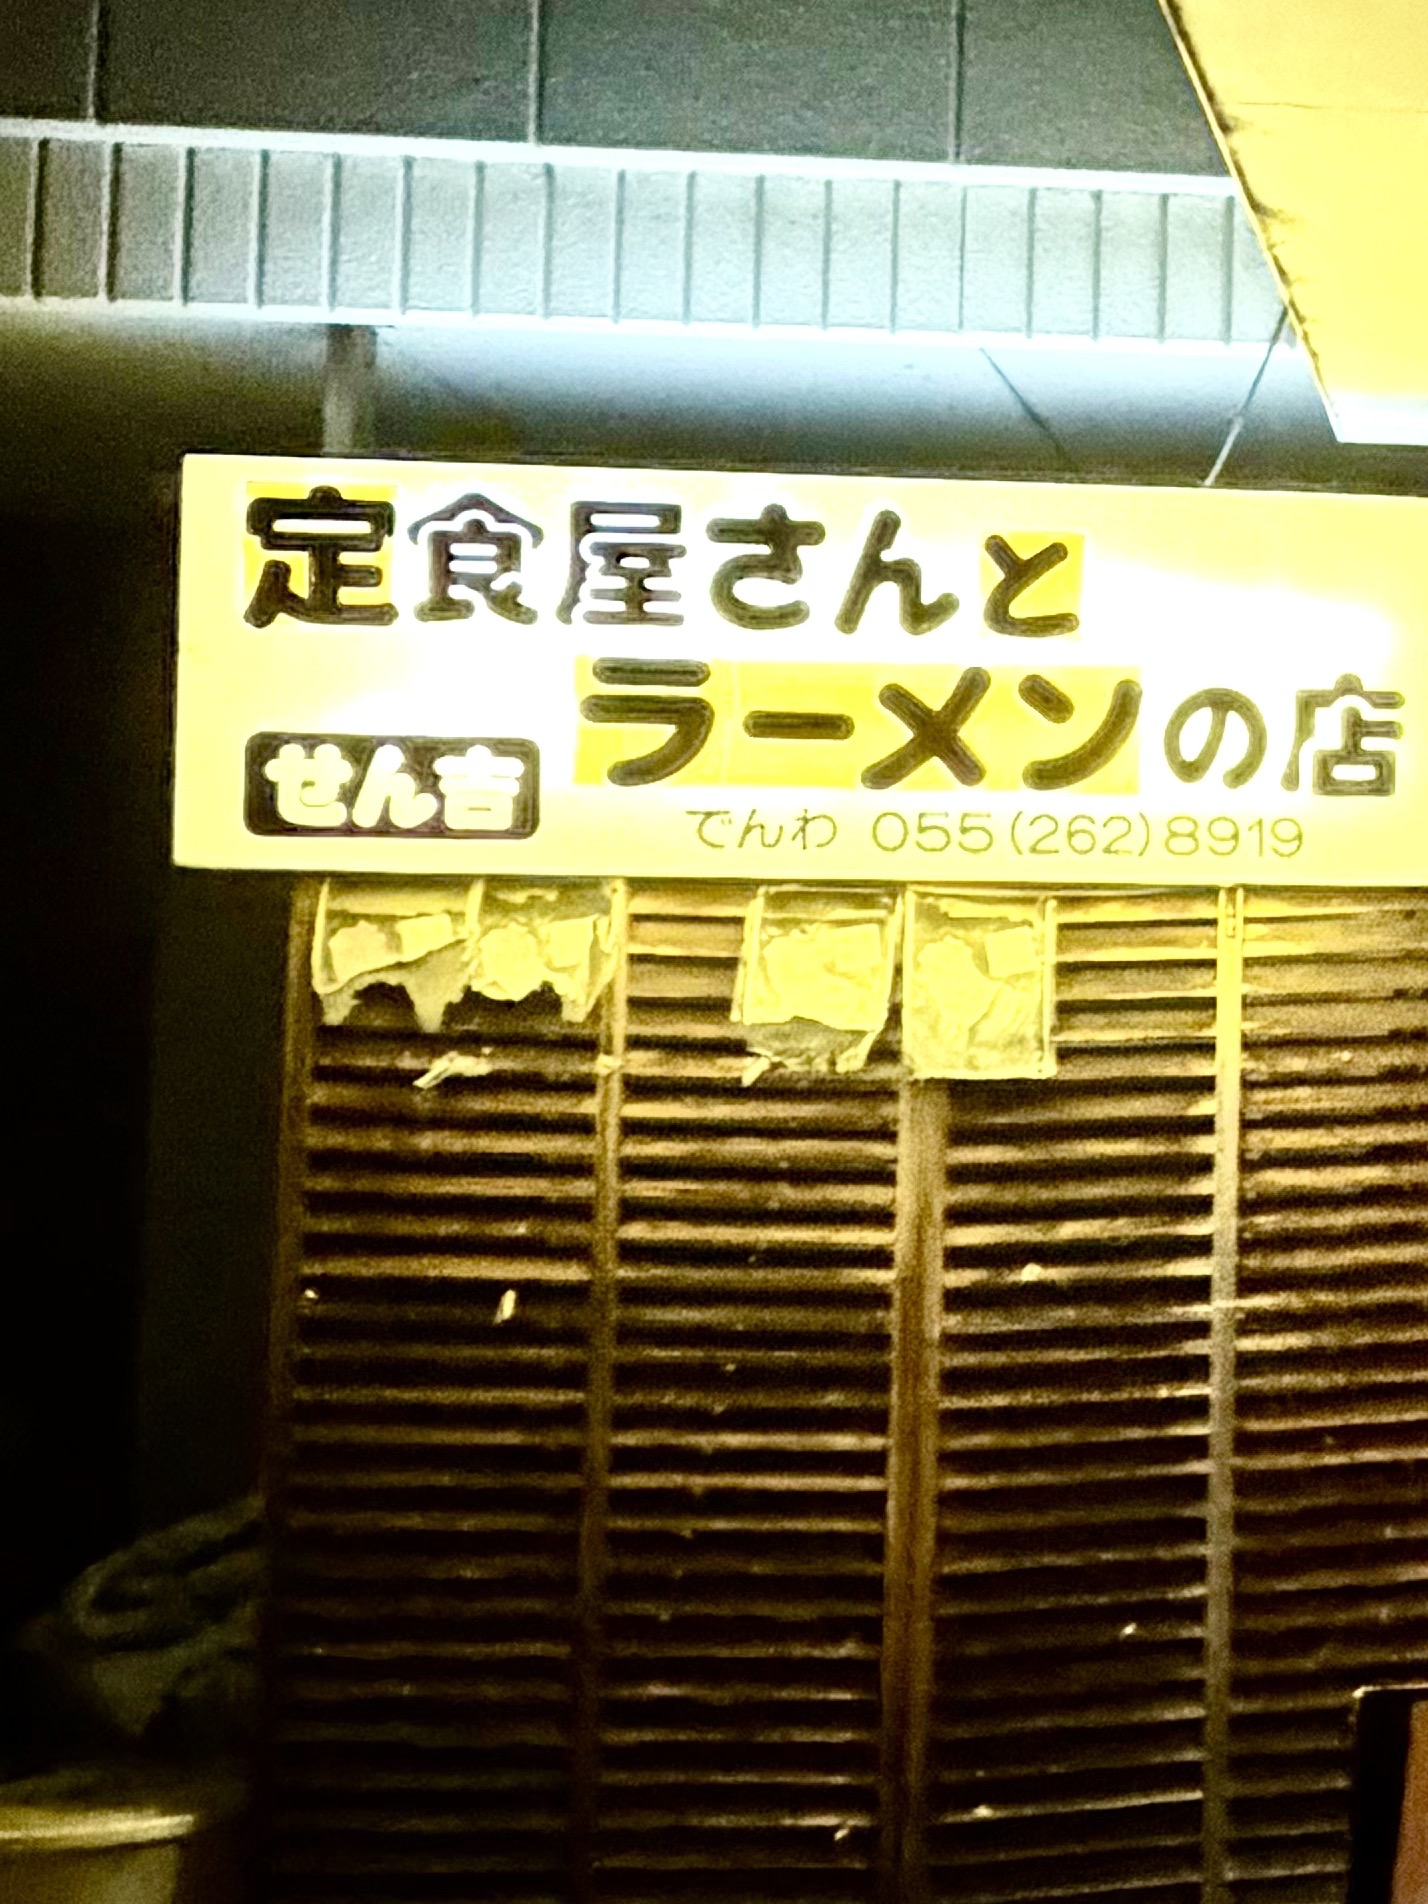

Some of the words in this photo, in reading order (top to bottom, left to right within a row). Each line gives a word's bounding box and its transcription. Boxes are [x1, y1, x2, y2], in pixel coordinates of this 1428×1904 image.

[244, 487, 1078, 634] 定食屋さんと
[582, 658, 1402, 796] ラーメンの店
[264, 743, 524, 831] せん吉
[686, 807, 838, 851] でんわ
[870, 809, 1305, 860] 055(262)8919
